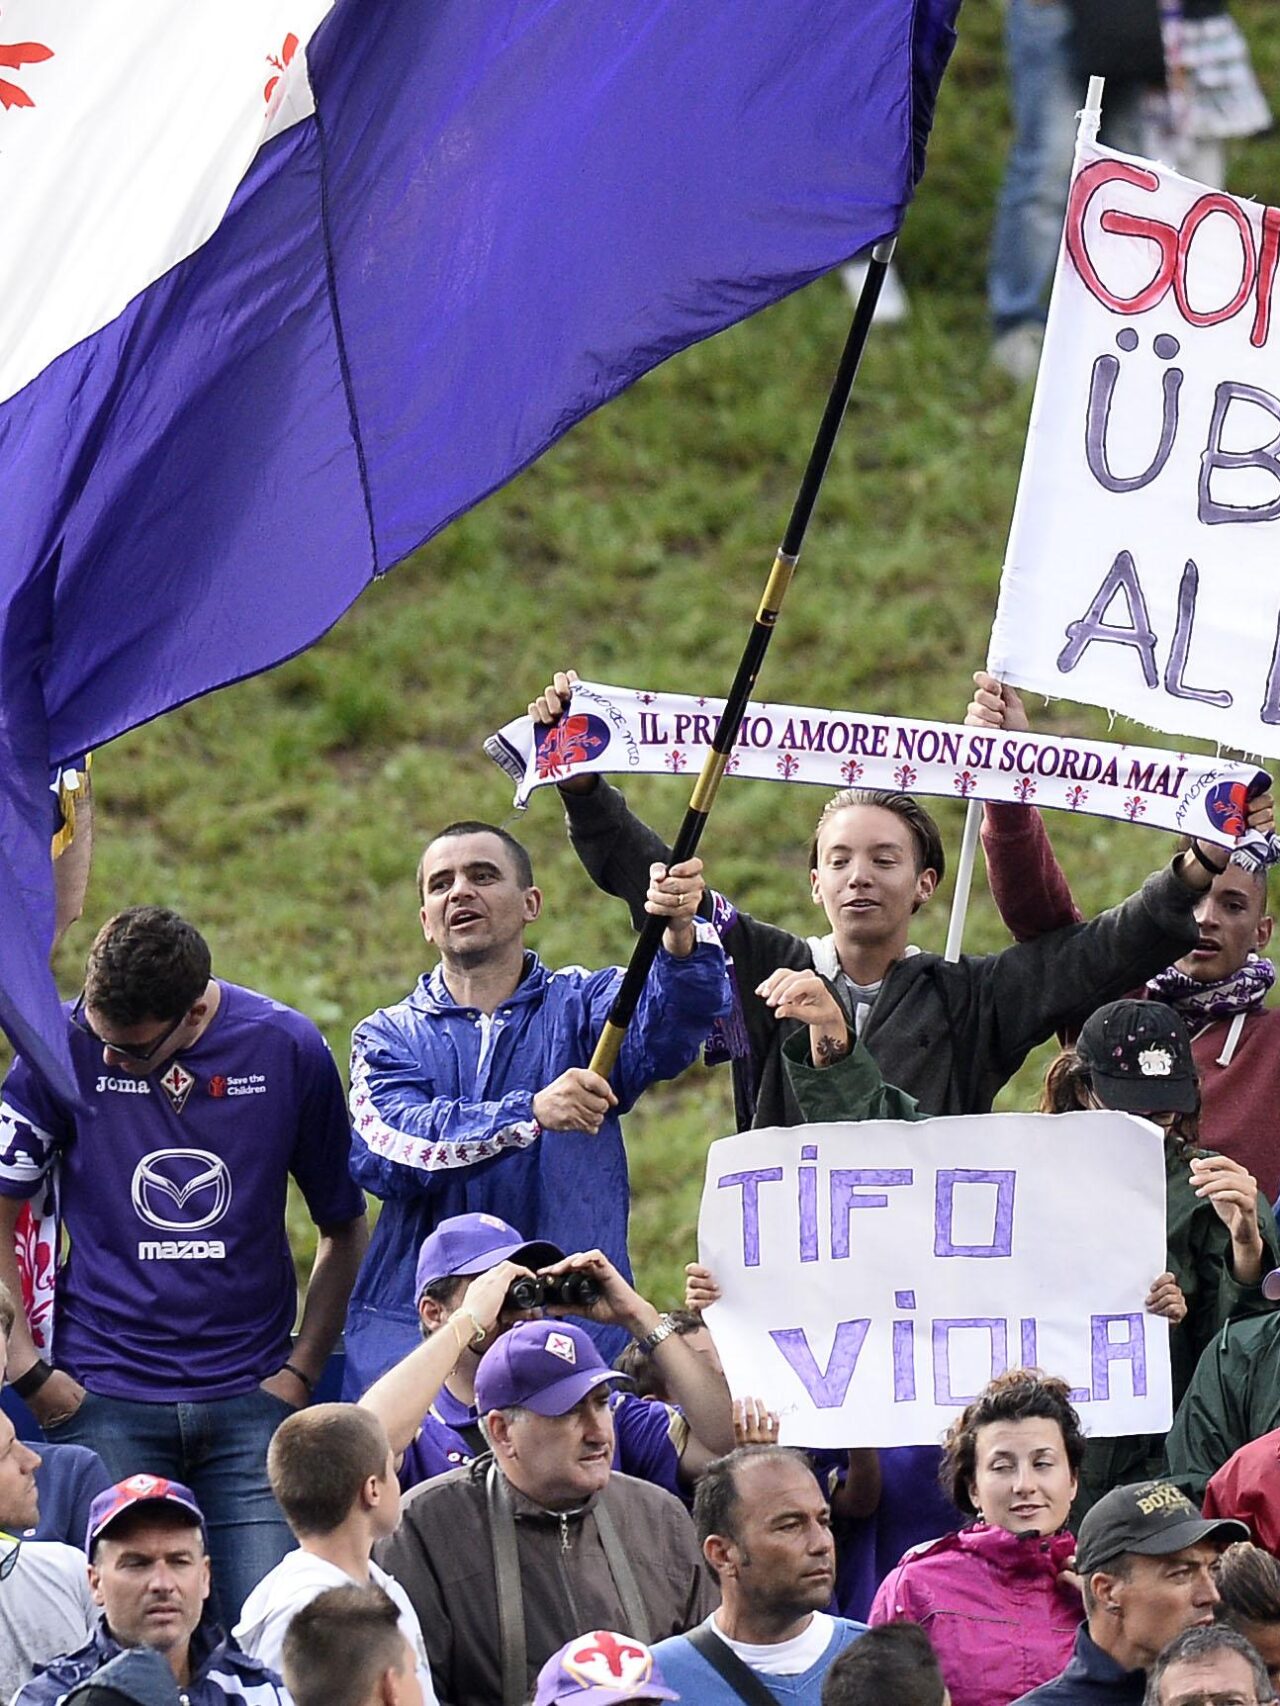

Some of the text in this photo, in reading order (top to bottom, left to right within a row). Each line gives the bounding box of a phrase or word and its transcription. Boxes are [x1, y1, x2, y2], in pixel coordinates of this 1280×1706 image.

[638, 712, 669, 745] IL
[778, 718, 889, 757] AMORE
[893, 727, 963, 766] NON
[966, 736, 996, 770] SI
[997, 740, 1118, 786] SCORDA
[1123, 760, 1188, 798] MAI
[227, 1074, 266, 1086] Save the
[227, 1085, 267, 1095] Children
[138, 1241, 226, 1260] mazda
